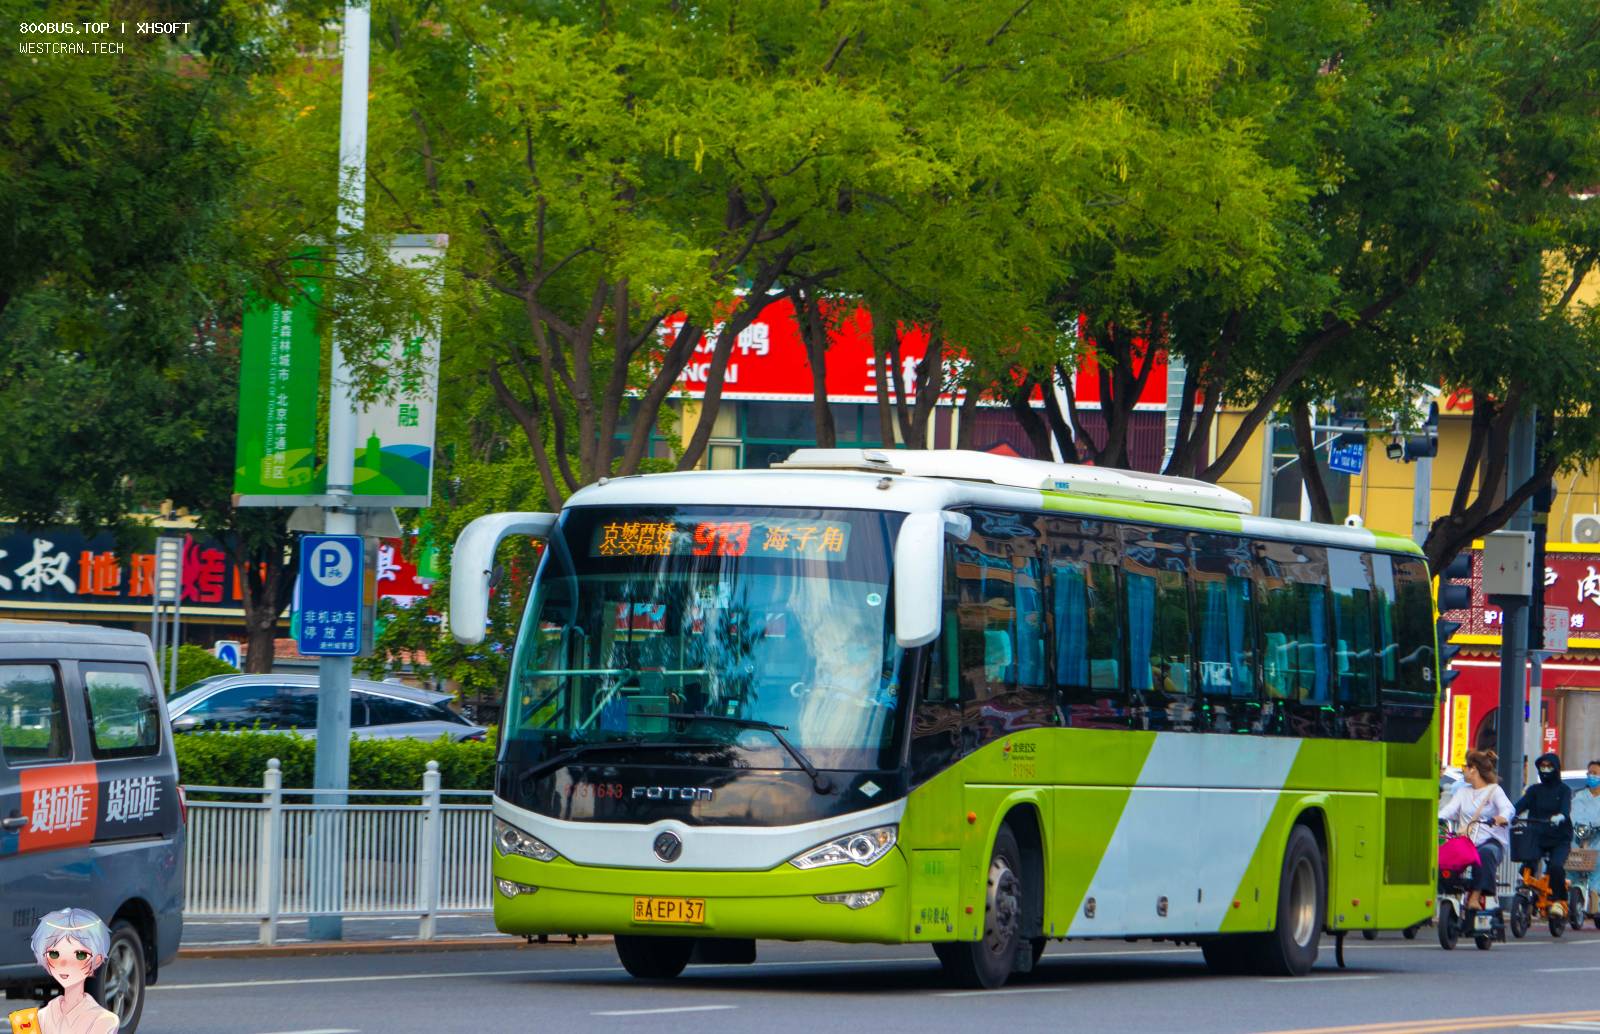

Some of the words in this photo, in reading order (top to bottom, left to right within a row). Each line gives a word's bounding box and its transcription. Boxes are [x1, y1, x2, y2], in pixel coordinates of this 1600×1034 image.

[692, 522, 751, 556] 913
[762, 525, 844, 553] 海子角
[319, 549, 341, 578] P
[304, 611, 356, 624] 非机动车
[304, 625, 356, 639] 停放点
[105, 776, 163, 823] 货拉拉
[631, 786, 713, 800] FOTON
[30, 784, 91, 833] 货拉拉
